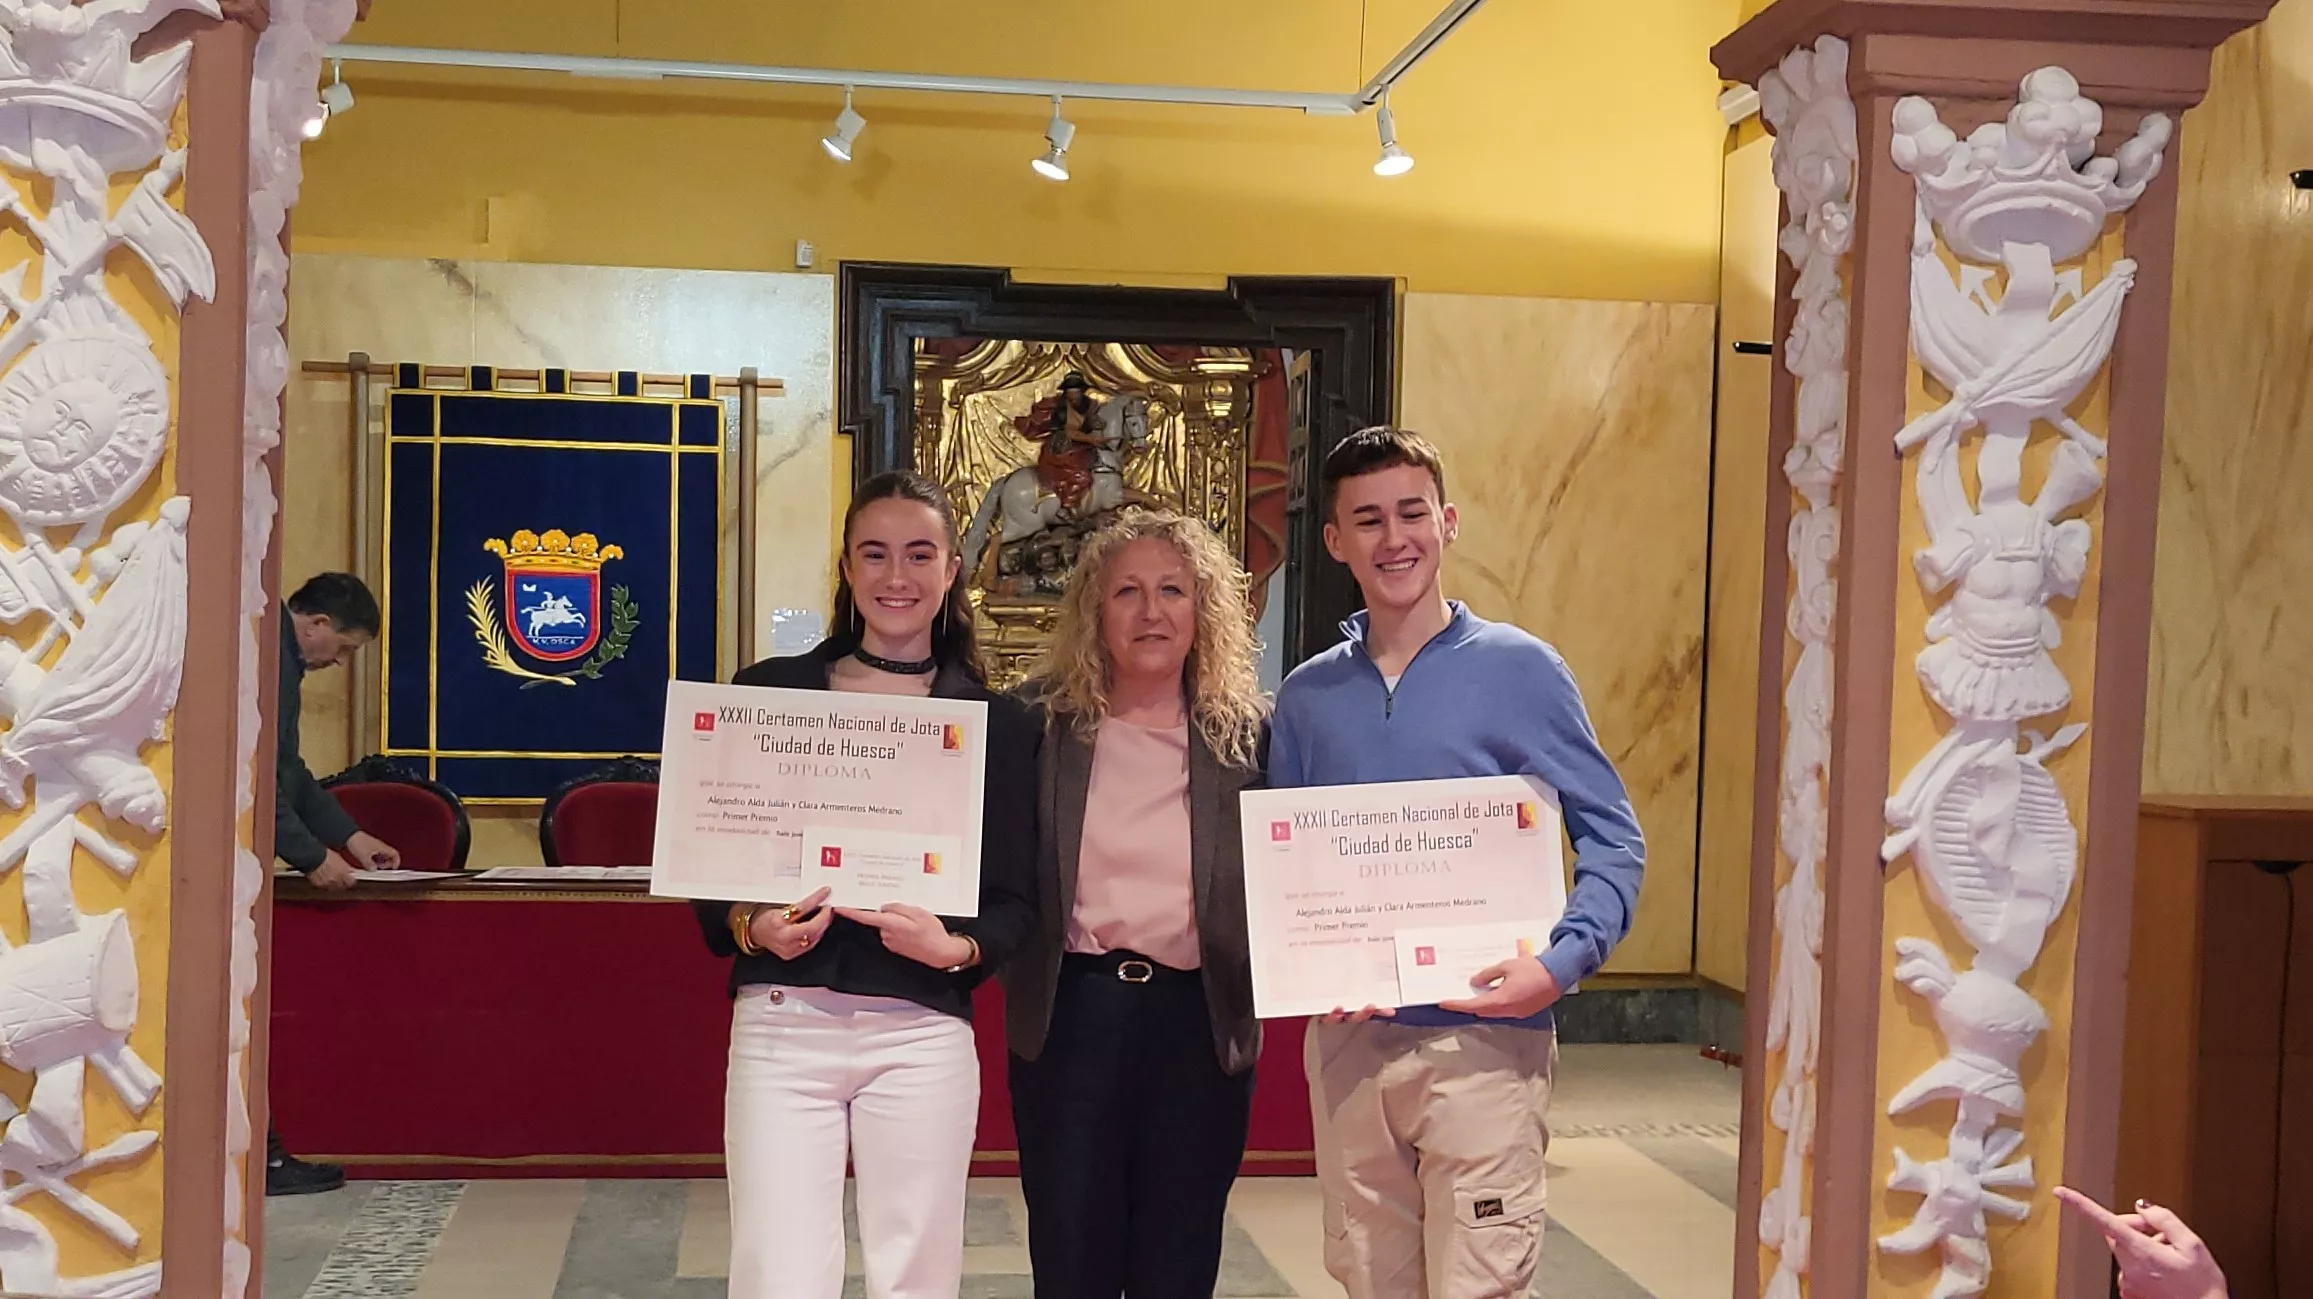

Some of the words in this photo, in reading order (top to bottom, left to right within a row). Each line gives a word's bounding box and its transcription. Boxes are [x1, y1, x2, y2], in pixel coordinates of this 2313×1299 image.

[718, 705, 752, 724] XXXII
[757, 708, 824, 728] Certamen
[828, 712, 886, 732] Nacional
[890, 716, 906, 733] de
[911, 718, 940, 736] Jota
[753, 733, 812, 755] "Ciudad
[817, 737, 835, 756] de
[841, 738, 904, 760] Huesca"
[778, 762, 871, 780] DIPLOMA
[707, 796, 746, 808] Alejandro
[747, 798, 765, 807] Alda
[767, 799, 790, 809] Julián
[798, 800, 818, 810] Clara
[820, 802, 867, 813] Armenteros
[868, 804, 903, 815] Medrano
[1294, 809, 1327, 829] XXXII
[1331, 809, 1398, 828] Certamen
[1402, 802, 1459, 823] Nacional
[1463, 801, 1480, 819] de
[1484, 800, 1513, 818] Jota
[722, 811, 748, 821] Primer
[750, 812, 778, 822] Premio
[1331, 832, 1389, 856] "Ciudad
[1395, 832, 1412, 853] de
[1417, 827, 1479, 851] Huesca"
[1358, 860, 1452, 878] DIPLOMA
[1296, 908, 1333, 918] Alejandro
[1384, 902, 1404, 911] Clara
[1406, 901, 1451, 910] Armenteros
[1453, 898, 1487, 907] Medrano
[1314, 923, 1339, 932] Primer
[1341, 921, 1369, 930] Premio
